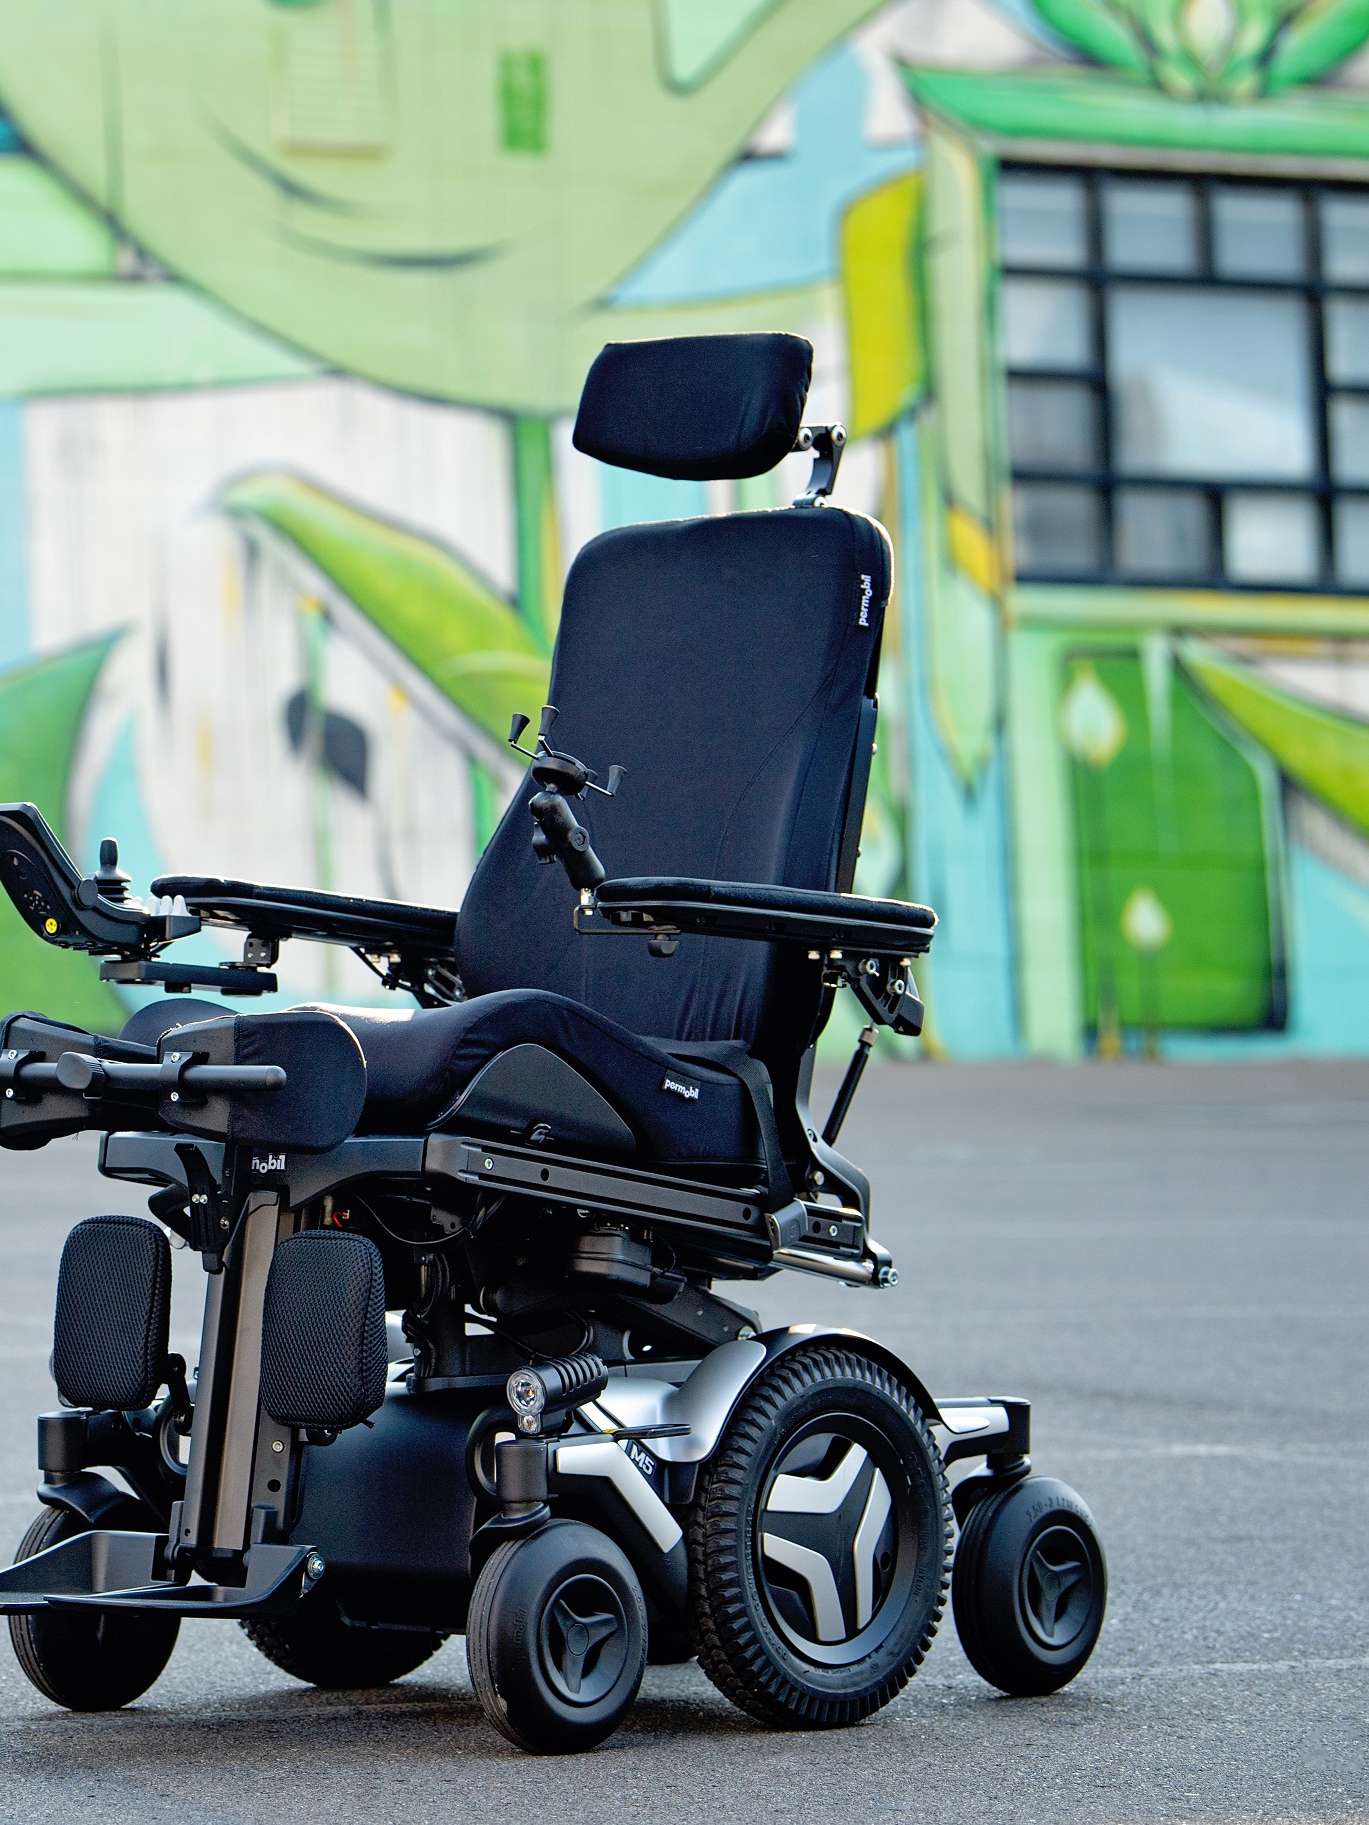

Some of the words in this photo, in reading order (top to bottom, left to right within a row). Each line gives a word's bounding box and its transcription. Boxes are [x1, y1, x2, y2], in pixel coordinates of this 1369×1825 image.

[859, 573, 873, 627] permobil
[664, 1078, 700, 1101] permobil
[629, 1442, 655, 1476] M5
